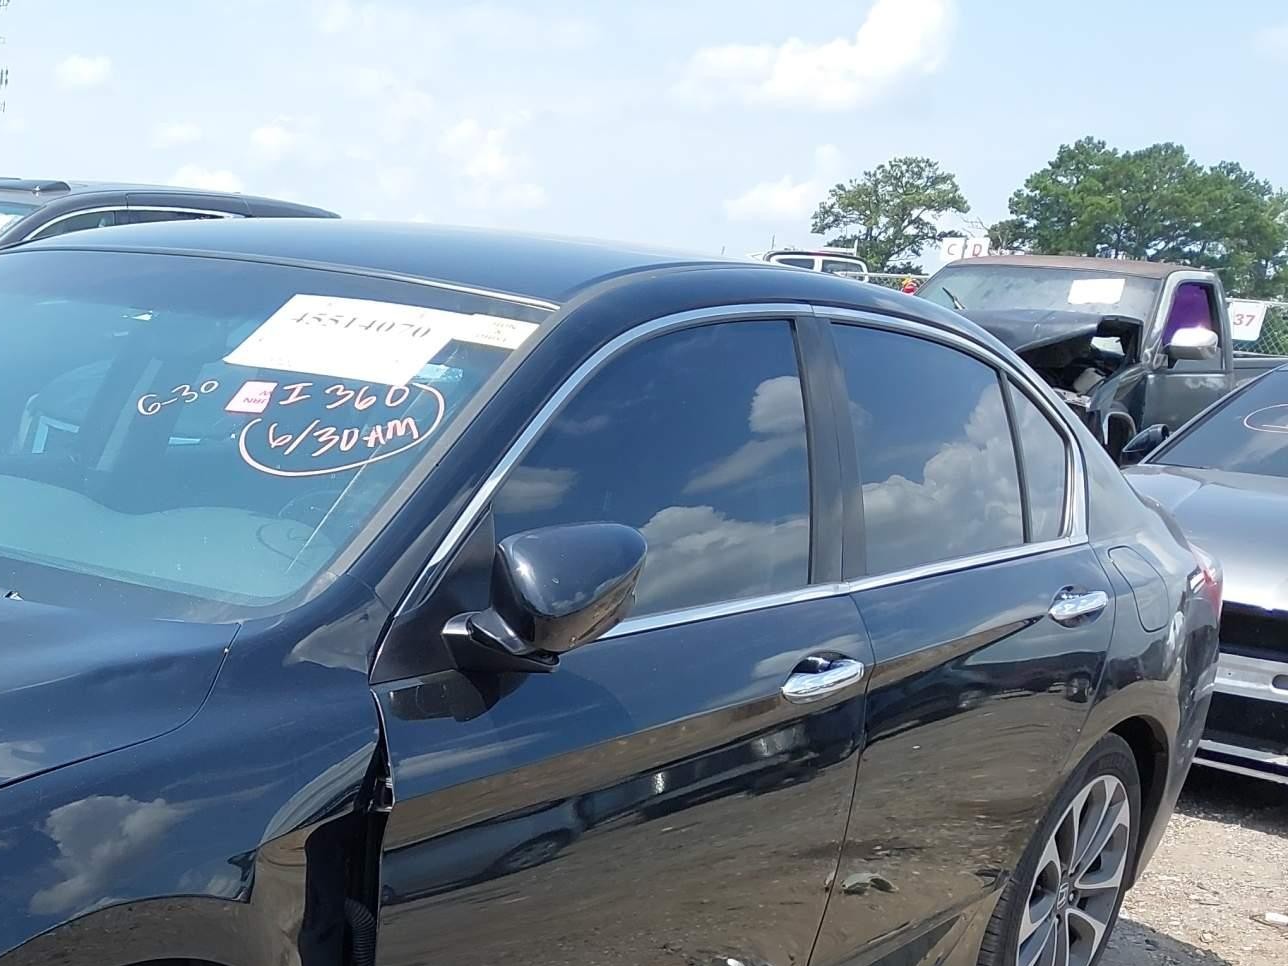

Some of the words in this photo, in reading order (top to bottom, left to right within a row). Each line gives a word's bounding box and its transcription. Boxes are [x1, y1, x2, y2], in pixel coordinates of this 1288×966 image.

[972, 243, 982, 257] D
[1233, 313, 1256, 327] 37
[324, 384, 410, 411] 360
